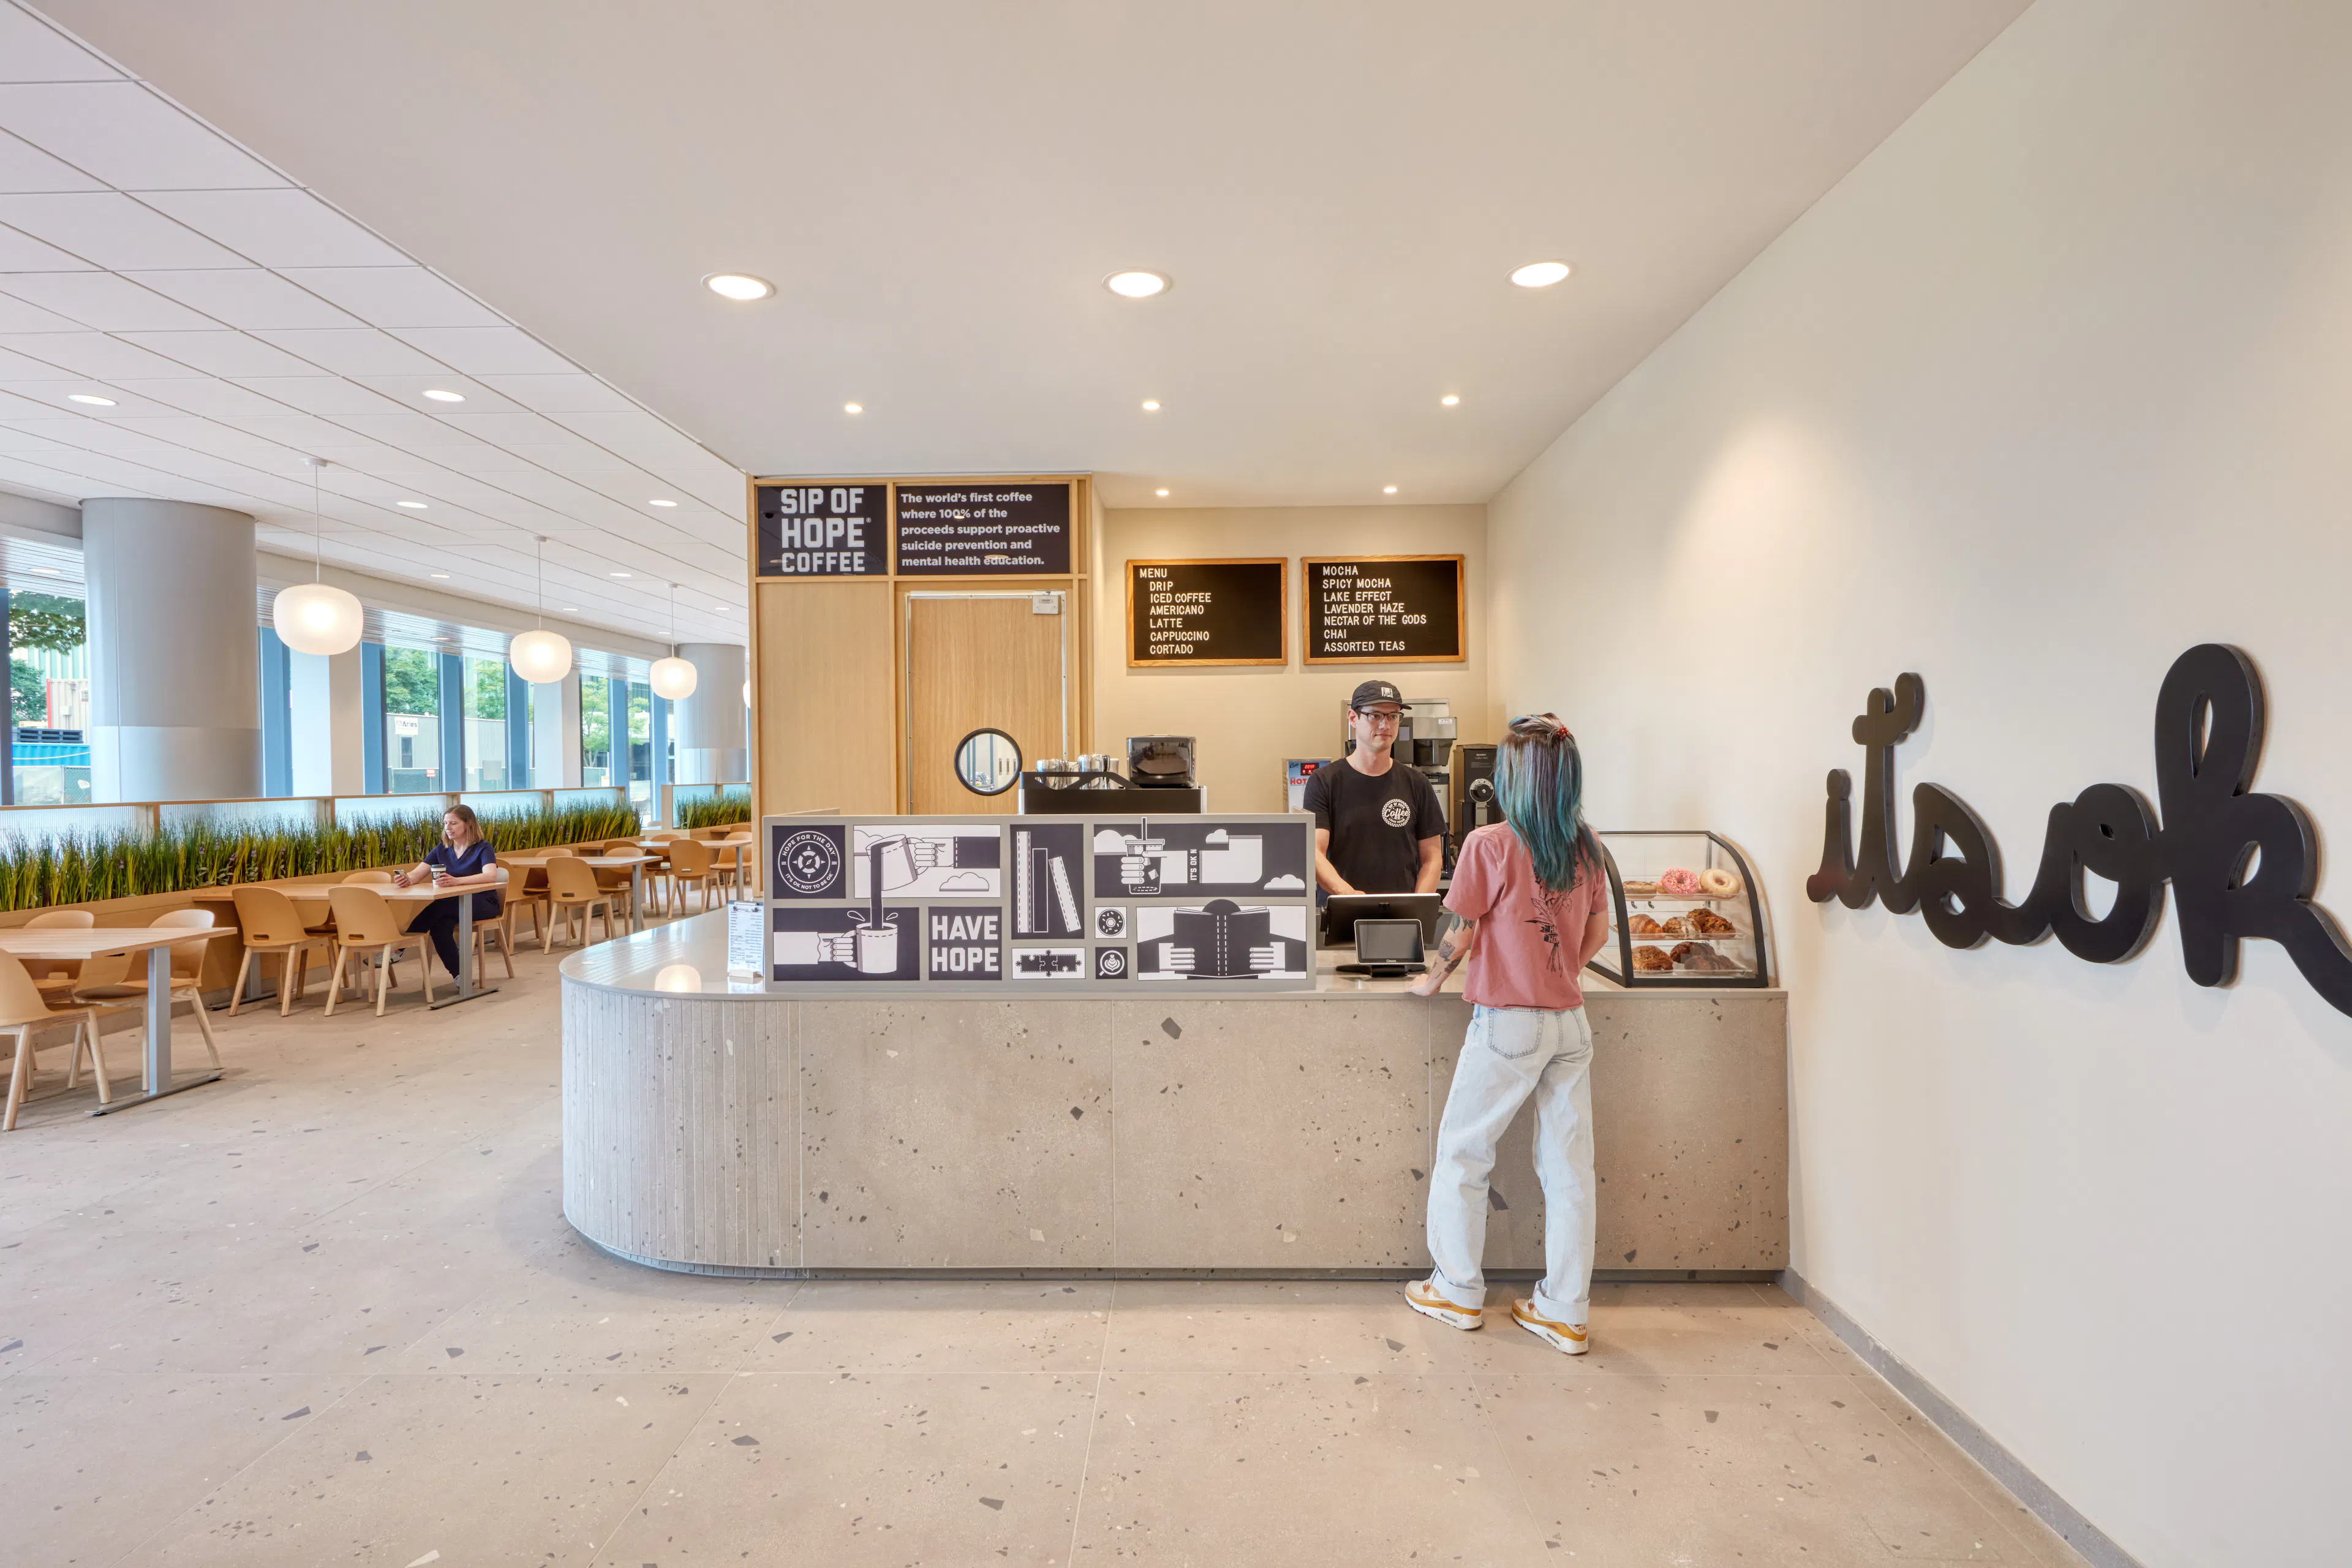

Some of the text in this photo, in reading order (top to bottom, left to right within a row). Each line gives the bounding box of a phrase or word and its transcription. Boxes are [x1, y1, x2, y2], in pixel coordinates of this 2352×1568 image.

[781, 488, 864, 513] SIP OF
[901, 492, 1033, 503] The world’s first coffee
[901, 508, 1008, 519] where 100% of the
[901, 523, 1060, 537] proceeds support proactive
[901, 539, 1032, 551] suicide prevention and
[782, 552, 865, 572] COFFEE
[902, 554, 1044, 566] mental health education.
[1139, 568, 1167, 578] MENU
[1322, 565, 1359, 576] MOCHA
[1149, 581, 1174, 592] DRIP
[1322, 578, 1392, 589] SPICY MOCHA
[1150, 592, 1212, 603] ICED COFFEE
[1324, 590, 1392, 602] LAKE EFFECT
[1150, 605, 1204, 616] AMERICANO
[1324, 603, 1405, 614] LAVENDER HAZE
[1150, 617, 1183, 628] LATTE
[1324, 614, 1427, 626] NECTAR OF THE GODS
[1150, 631, 1210, 642] CAPPUCCINO
[1324, 628, 1347, 639] CHAI
[1150, 644, 1194, 655] CORTADO
[1324, 641, 1406, 652] ASSORTED TEAS
[1384, 807, 1409, 820] Coffee
[782, 839, 796, 856] HOPE
[813, 835, 826, 844] THE
[825, 842, 835, 856] DAY
[1189, 856, 1197, 865] OK
[932, 915, 998, 940] HAVE
[932, 947, 999, 972] HOPE
